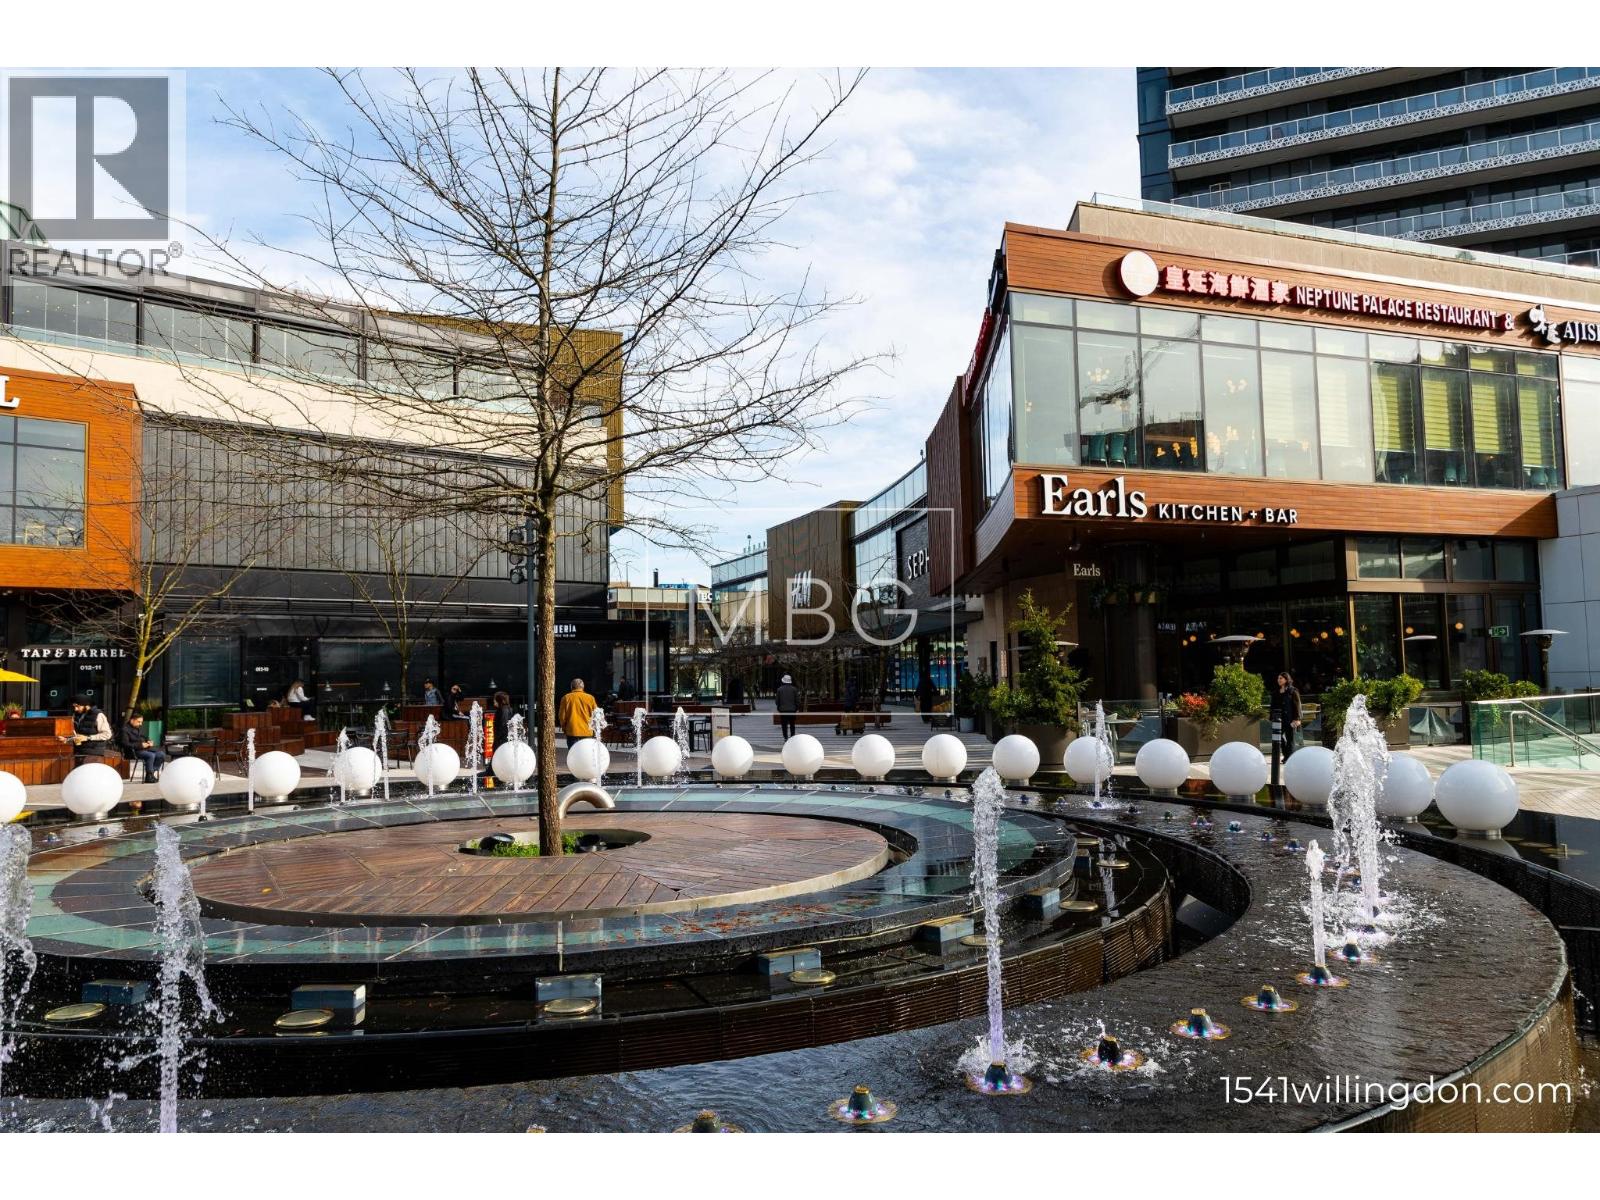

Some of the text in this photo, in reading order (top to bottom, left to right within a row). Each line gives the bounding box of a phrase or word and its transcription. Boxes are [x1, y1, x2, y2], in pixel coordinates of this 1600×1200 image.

[1296, 285, 1360, 312] NEPTUNE
[1362, 295, 1412, 318] PALACE
[1415, 302, 1497, 329] RESTAURANT
[1504, 312, 1514, 330] &
[1041, 473, 1148, 518] Earls
[1158, 503, 1243, 522] KITCHEN
[1265, 508, 1298, 524] BAR
[1073, 563, 1101, 577] Earls
[21, 648, 126, 658] TAP & BARREL
